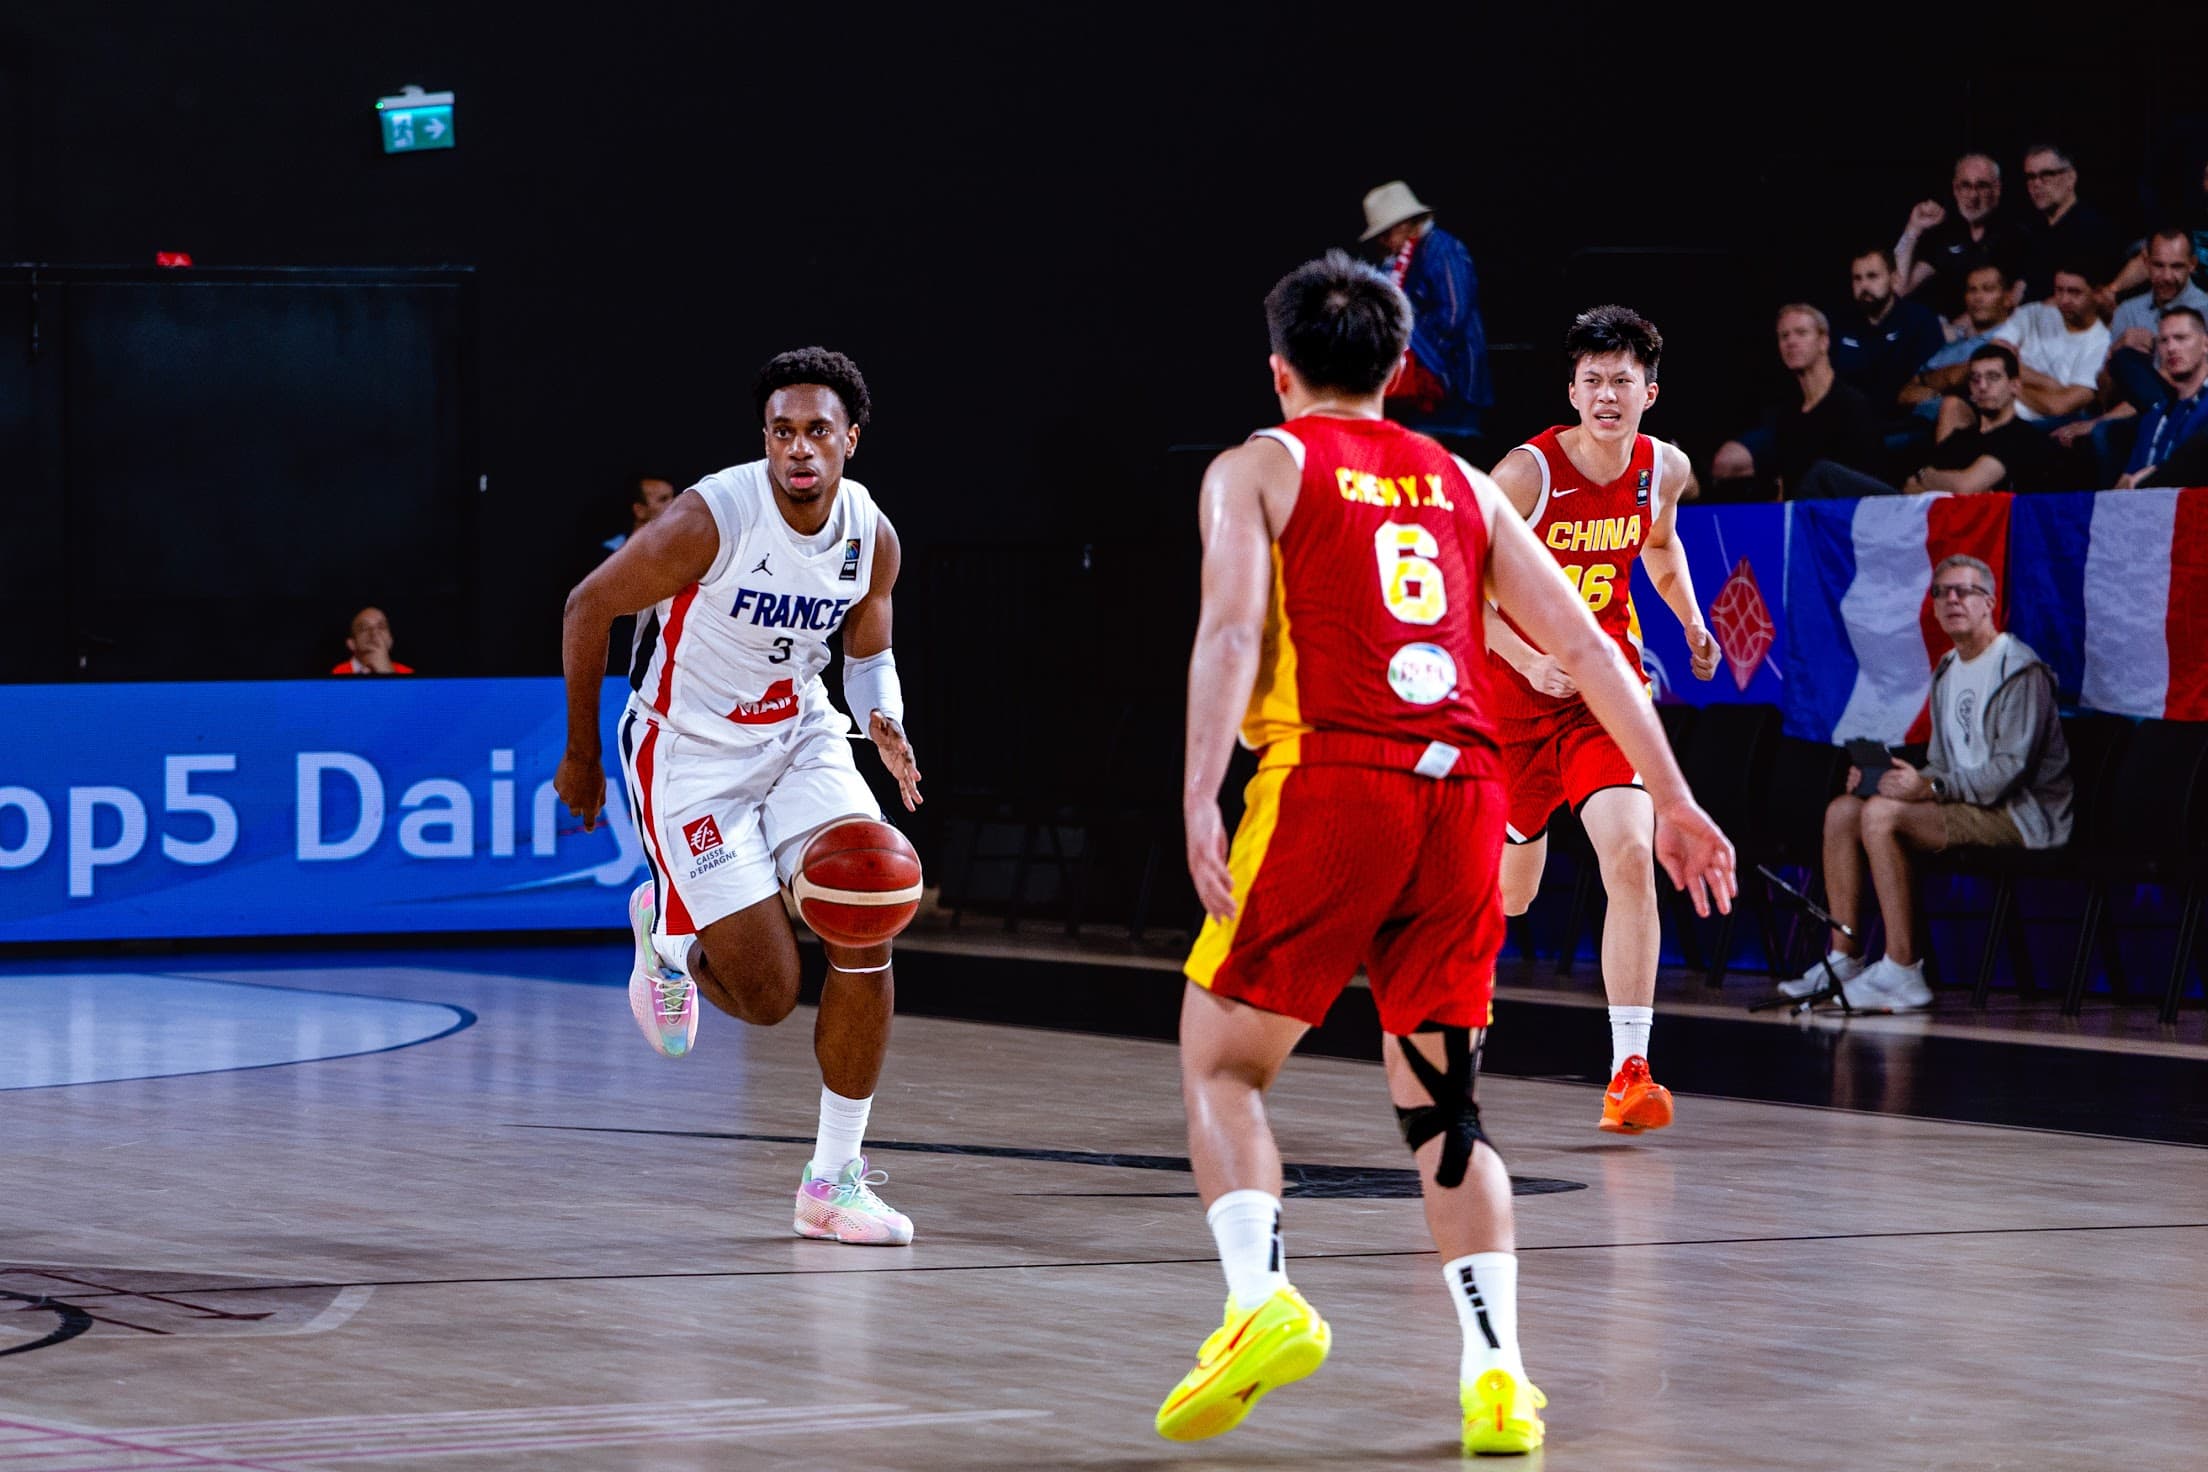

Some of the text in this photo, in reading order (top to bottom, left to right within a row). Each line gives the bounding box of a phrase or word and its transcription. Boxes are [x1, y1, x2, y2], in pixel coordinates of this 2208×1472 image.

[1335, 466, 1401, 508] CHEN
[1546, 514, 1641, 552] CHINA
[1374, 519, 1448, 626] 6
[729, 587, 852, 630] FRANCE
[768, 636, 794, 665] 3
[0, 753, 240, 898] op5
[689, 850, 738, 879] D'EPARGNE
[696, 847, 725, 866] CAISSE
